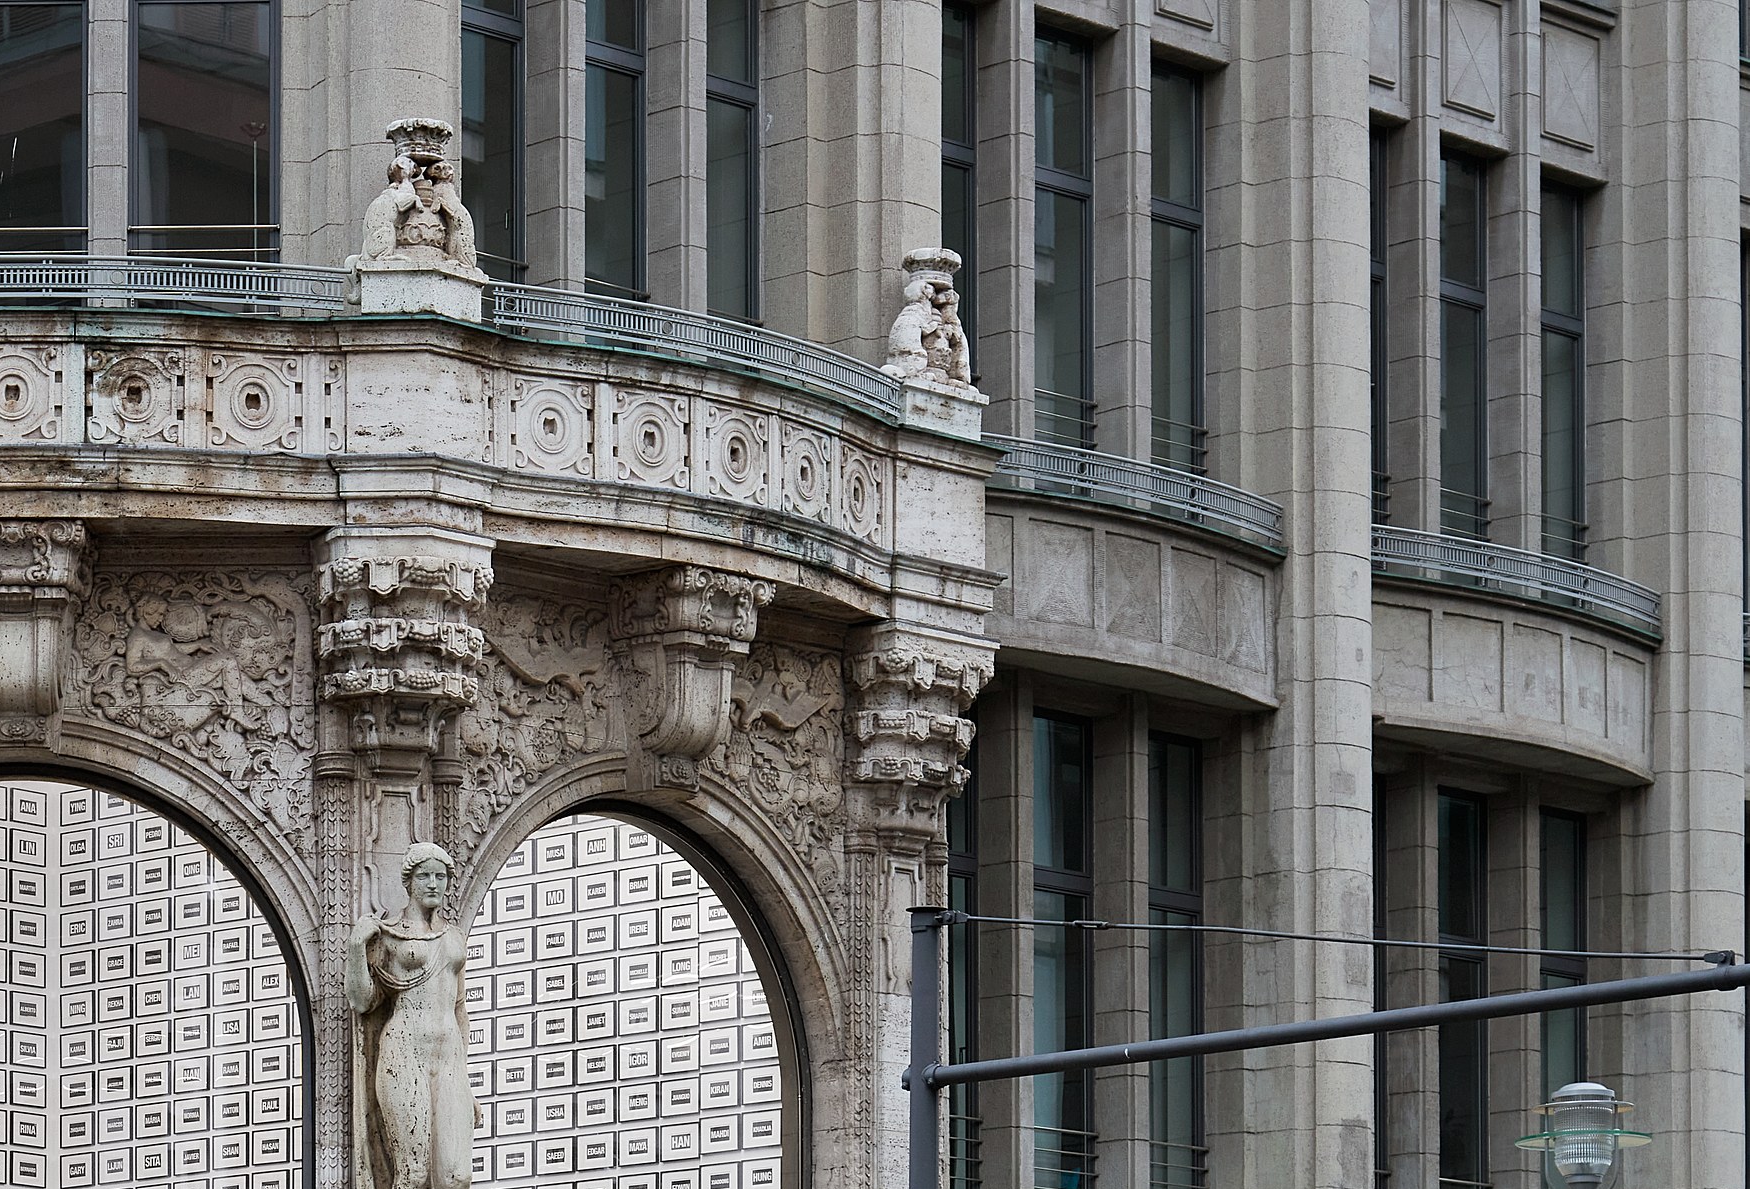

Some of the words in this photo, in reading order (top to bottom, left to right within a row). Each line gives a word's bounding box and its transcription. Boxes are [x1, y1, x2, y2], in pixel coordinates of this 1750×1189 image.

[20, 801, 36, 814] ANA
[70, 800, 86, 813] YING
[20, 840, 35, 855] LIN
[108, 833, 123, 849] SRI
[588, 839, 605, 853] ANH
[547, 848, 564, 859] MUSA
[547, 890, 564, 905] MO
[70, 922, 85, 935] ERIC
[262, 976, 279, 987] ALEX
[184, 985, 199, 999] LAN
[223, 1021, 239, 1034] LISA
[630, 1053, 647, 1066] IGOR
[262, 1100, 278, 1111] RAUL
[672, 1134, 689, 1149] HAN
[587, 1146, 605, 1156] EDGAR
[145, 1155, 161, 1167] SITA
[70, 1165, 85, 1176] GARY
